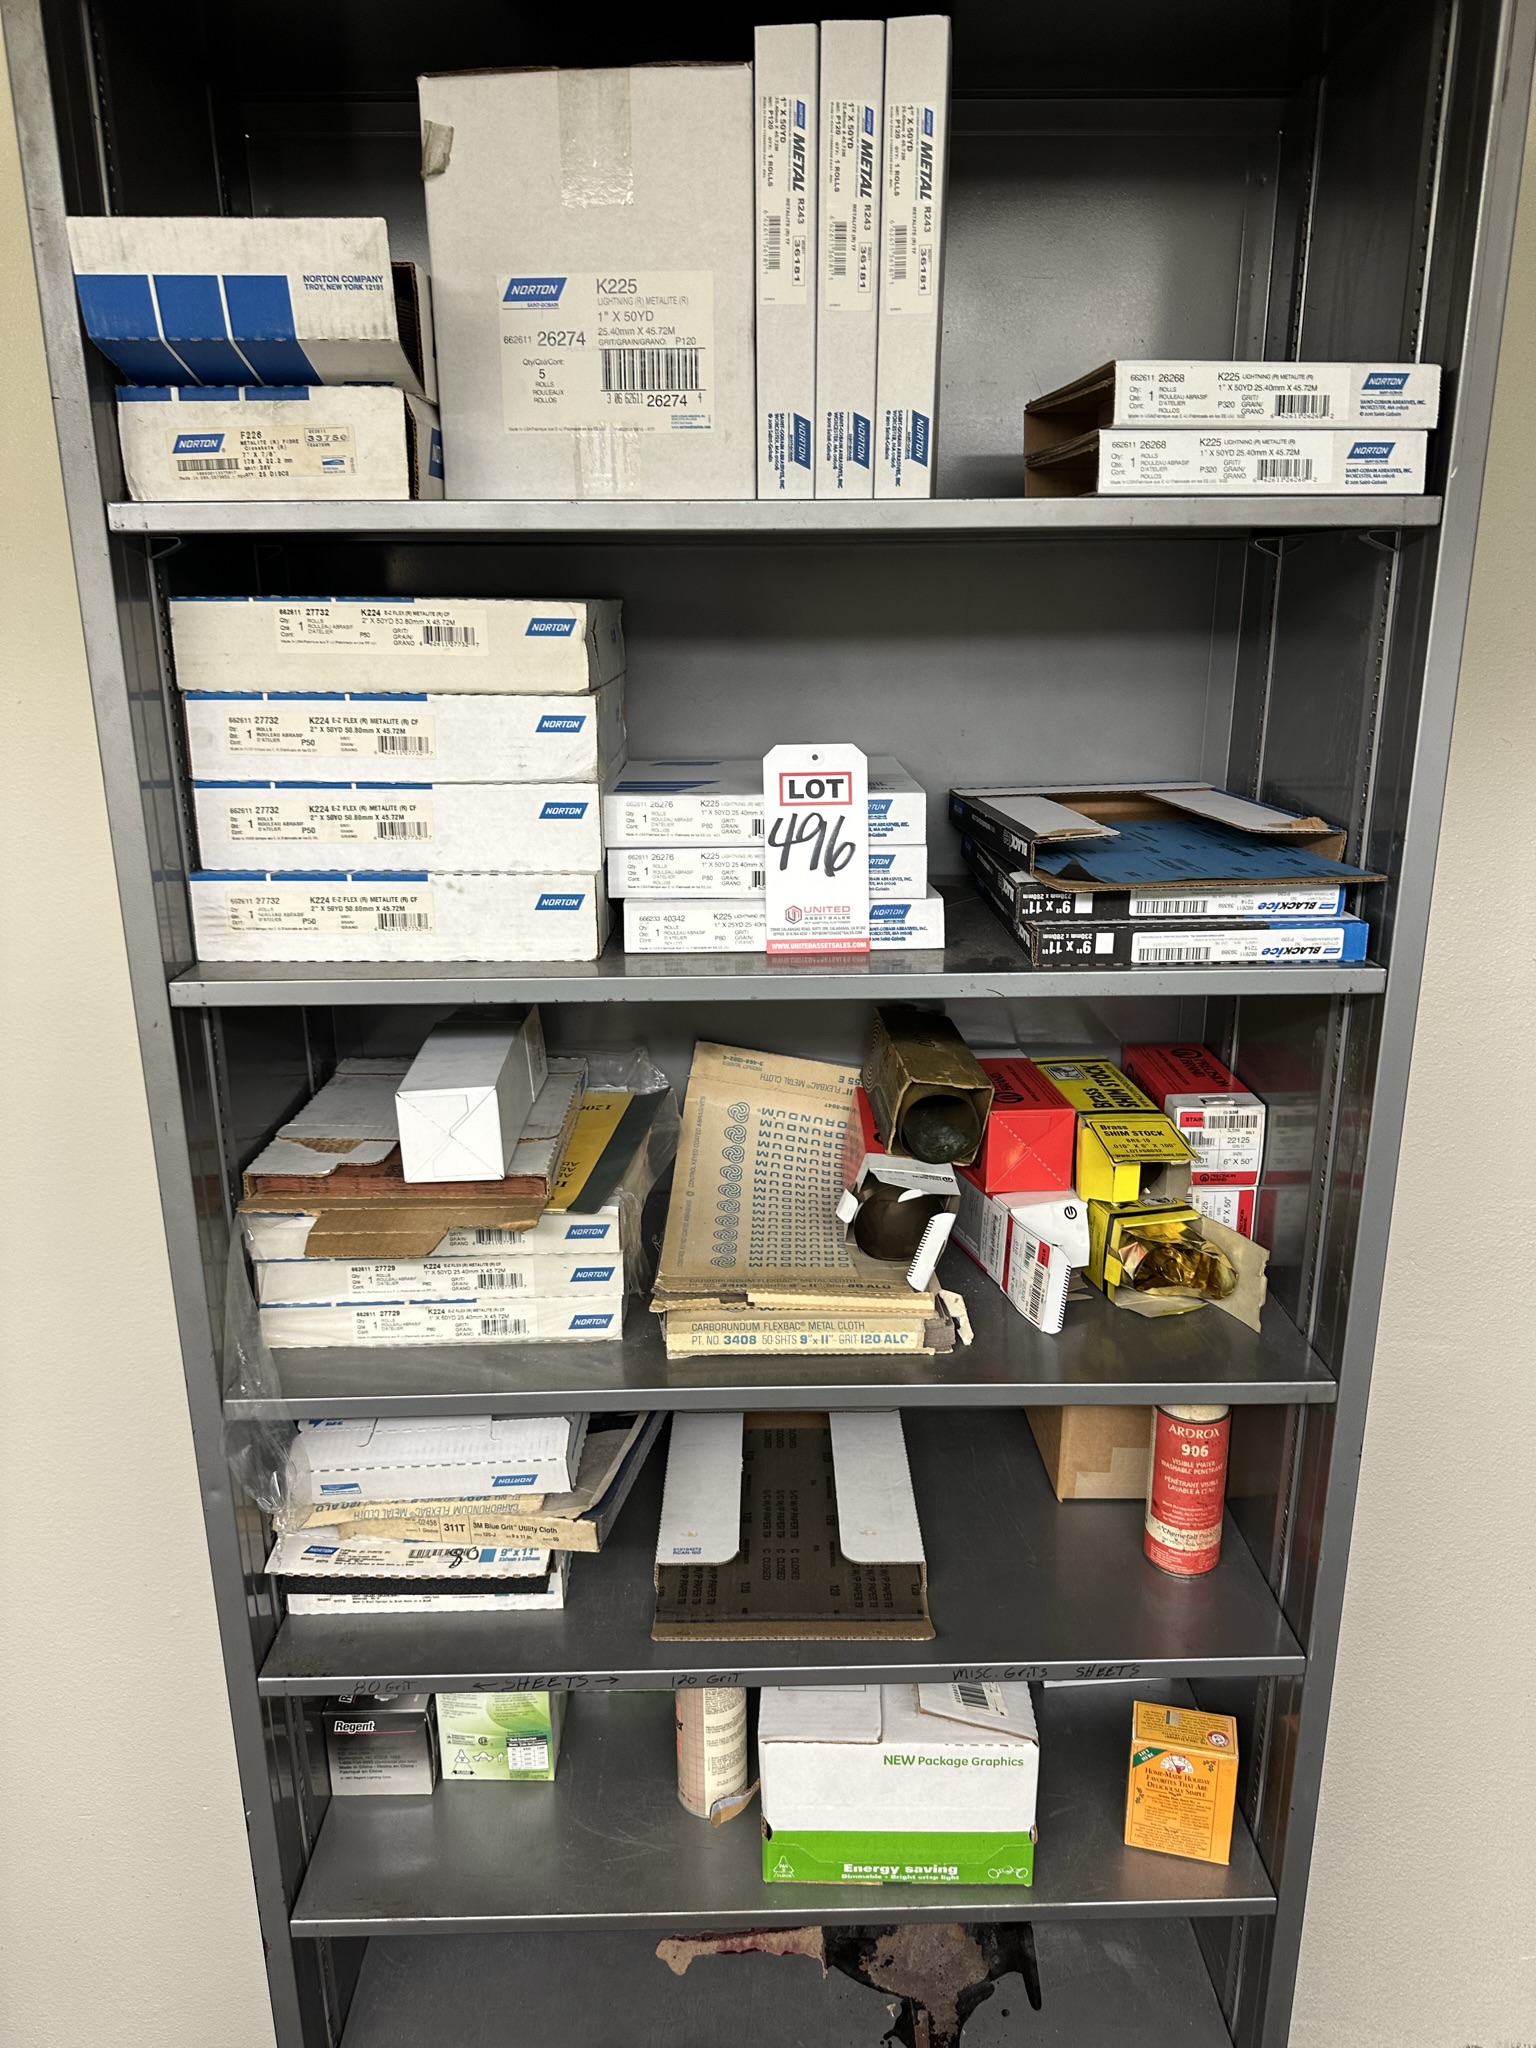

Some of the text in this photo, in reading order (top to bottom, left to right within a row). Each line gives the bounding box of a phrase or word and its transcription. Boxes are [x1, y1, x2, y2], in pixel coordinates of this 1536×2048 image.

[792, 132, 805, 192] METAL
[860, 138, 873, 198] METAL
[920, 140, 933, 200] METAL
[510, 284, 558, 295] NORTON
[596, 278, 637, 295] K225
[597, 297, 678, 306] LIGHTNING METALITE
[624, 311, 654, 322] 50YD
[598, 327, 675, 336] 25.40mm 45.72M
[503, 331, 586, 347] 662611 26274
[675, 337, 696, 346] P120
[538, 368, 546, 379] 5
[1158, 374, 1185, 383] 26268
[1218, 372, 1240, 381] K225
[1368, 377, 1403, 386] NORTON
[647, 394, 688, 407] 26274
[240, 431, 262, 440] F226
[798, 420, 806, 462] NORTON
[857, 420, 865, 461] NORTON
[915, 418, 924, 459] NORTON
[178, 440, 218, 449] NORTON
[1140, 440, 1166, 449] 26268
[1199, 438, 1221, 447] K225
[531, 623, 570, 632] NORTON
[542, 720, 580, 729] NORTON
[789, 779, 844, 799] LOT
[545, 807, 582, 815] NORTON
[768, 811, 856, 877] 496
[541, 898, 579, 907] NORTON
[1022, 901, 1071, 914] 9" 11"
[804, 905, 850, 913] UNITED
[771, 940, 867, 950] WWW.UNITEDASSETSALES.COM
[1042, 941, 1091, 954] 9" 11"
[760, 1073, 805, 1085] METAL CLOTH
[1080, 1064, 1120, 1088] STOCK
[692, 1323, 760, 1331] CARBORUNDUM
[808, 1322, 835, 1330] METAL
[838, 1321, 865, 1330] CLOTH
[692, 1334, 881, 1345] PT. NO. 3408 SHTS GRIT 120
[1168, 1424, 1220, 1439] ARDROX
[1181, 1444, 1209, 1457] 906
[1160, 1459, 1223, 1474] WASHABLE PENETRANT
[1172, 1457, 1194, 1468] VISIBLE
[1168, 1484, 1194, 1495] LAVABLE
[354, 1503, 519, 1520] CARBORUNDUM METAL CLOTH
[444, 1523, 466, 1532] 311T
[518, 1525, 537, 1533] Utility
[449, 1546, 479, 1568] 80
[1076, 1664, 1140, 1677] SHEETS
[502, 1676, 590, 1692] SHEETS
[672, 1674, 697, 1686] 120
[354, 1680, 381, 1695] 80
[334, 1721, 376, 1734] Regent
[884, 1755, 1024, 1768] NEW Package Graphics
[844, 1864, 958, 1875] Energy saving
